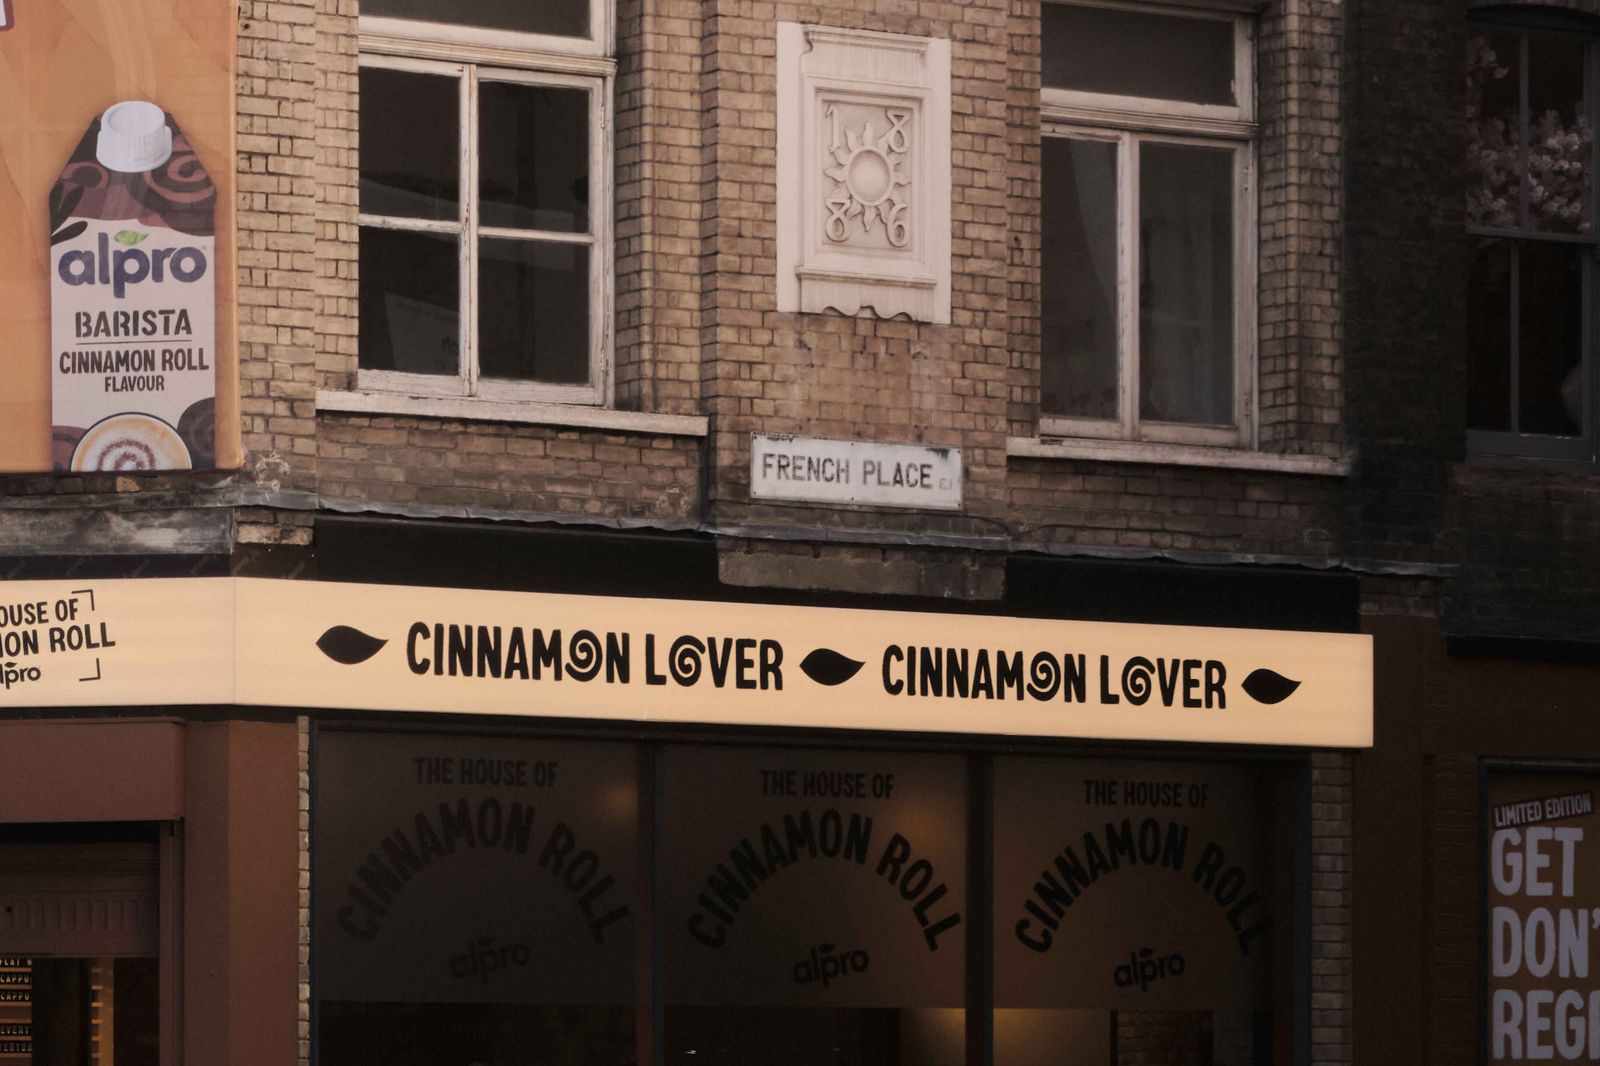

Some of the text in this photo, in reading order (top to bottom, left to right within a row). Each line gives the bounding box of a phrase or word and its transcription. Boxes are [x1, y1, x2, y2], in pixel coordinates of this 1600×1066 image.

[58, 232, 207, 298] alpro
[75, 308, 192, 338] BARISTA
[59, 348, 209, 374] CINNAMON ROLL
[105, 375, 164, 392] FLAVOUR
[761, 453, 850, 484] FRENCH
[862, 460, 933, 489] PLACE
[55, 598, 79, 622] OF
[49, 622, 116, 653] ROLL
[406, 622, 1227, 710] CINNAMON LOVER CINNAMON LOVER
[414, 757, 558, 788] THE HOUSE OF
[760, 769, 894, 799] THE HOUSE OF
[1083, 780, 1209, 808] THE HOUSE OF
[1494, 793, 1592, 827] LIMITED EDITION
[336, 797, 629, 945] CINNAMON ROLL
[1492, 826, 1584, 897] GET
[688, 809, 960, 952] CINNAMON ROLL
[1015, 818, 1274, 955] CINNAMON ROLL
[0, 973, 32, 984] CAPPU
[450, 940, 531, 984] alpro
[793, 947, 869, 989] alpro
[1113, 951, 1186, 992] alpro
